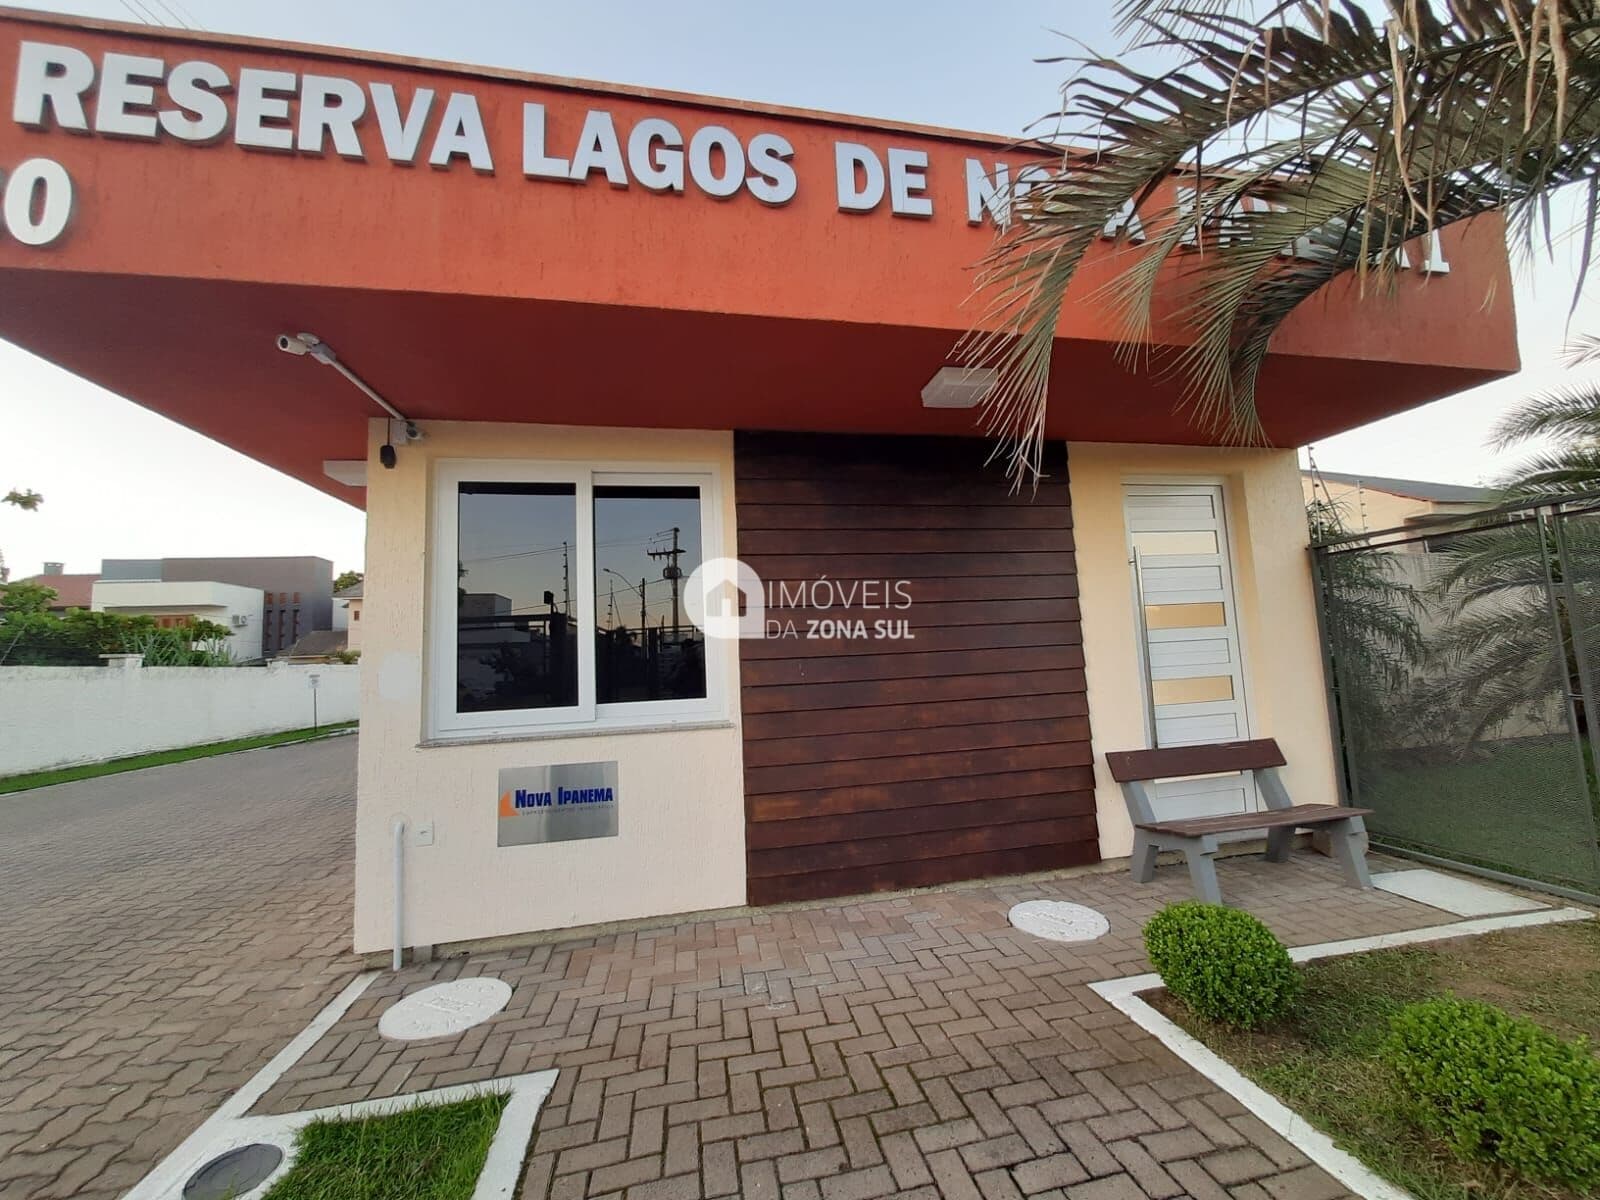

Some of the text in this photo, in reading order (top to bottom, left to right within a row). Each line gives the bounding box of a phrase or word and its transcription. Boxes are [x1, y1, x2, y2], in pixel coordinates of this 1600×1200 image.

[13, 40, 495, 175] RESERVA
[522, 102, 798, 206] LAGOS
[834, 140, 934, 218] DE
